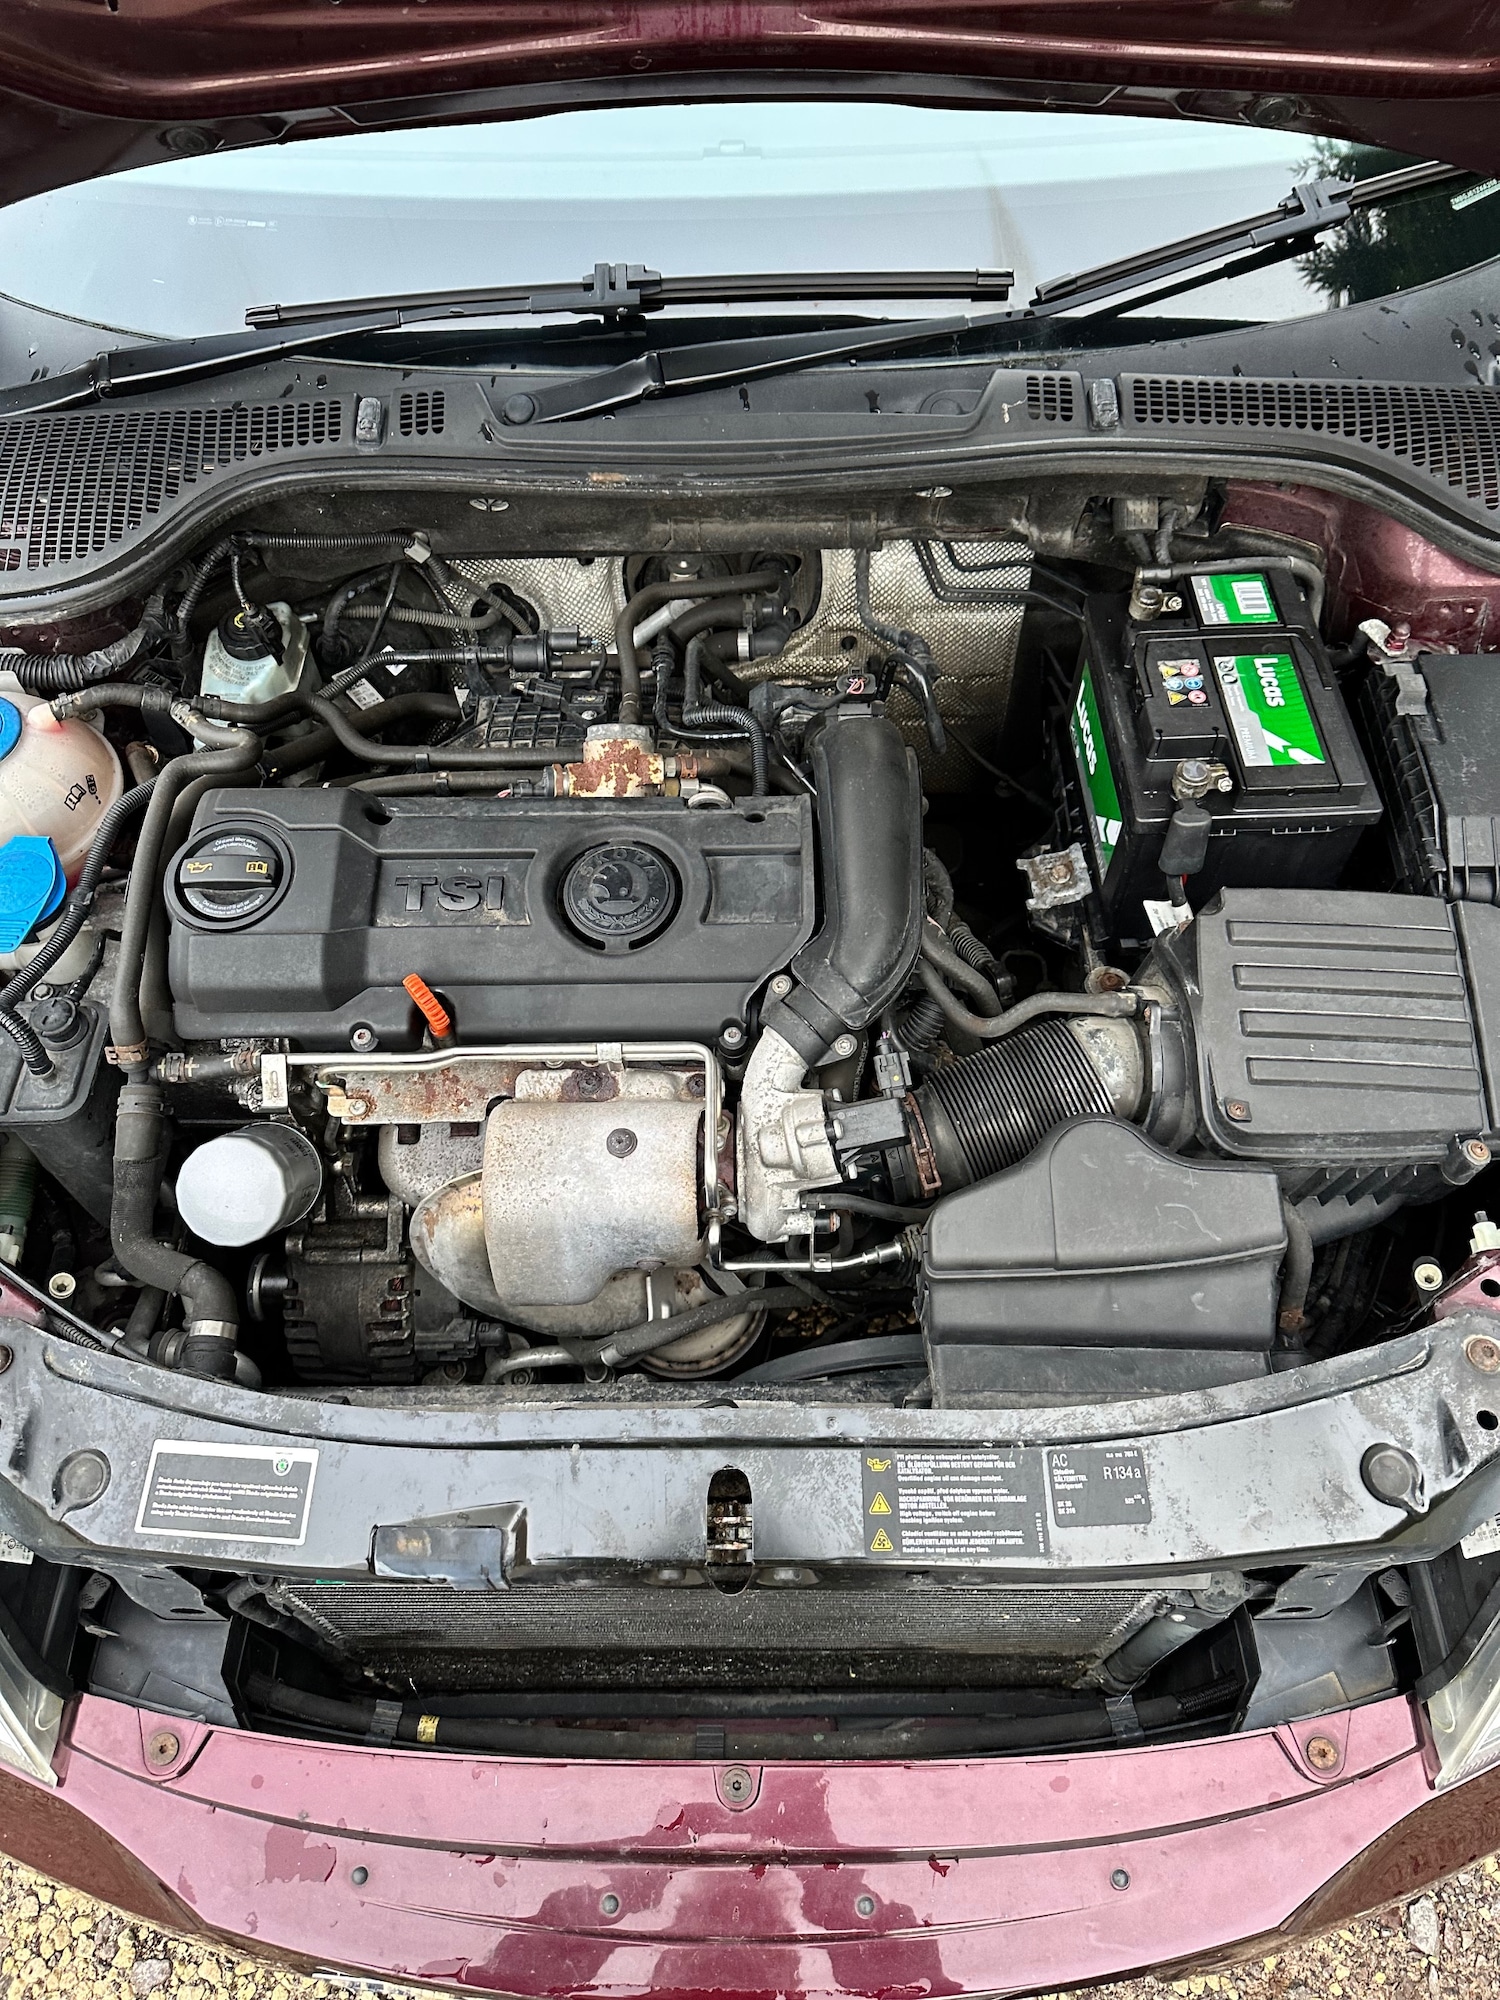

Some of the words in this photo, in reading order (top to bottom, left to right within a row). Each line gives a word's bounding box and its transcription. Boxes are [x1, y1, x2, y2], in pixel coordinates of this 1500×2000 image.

[1254, 658, 1285, 707] Lucas
[1076, 679, 1098, 775] Lucas
[1240, 727, 1257, 760] PREMIUM
[396, 876, 504, 912] TSI
[1052, 1454, 1068, 1467] AC
